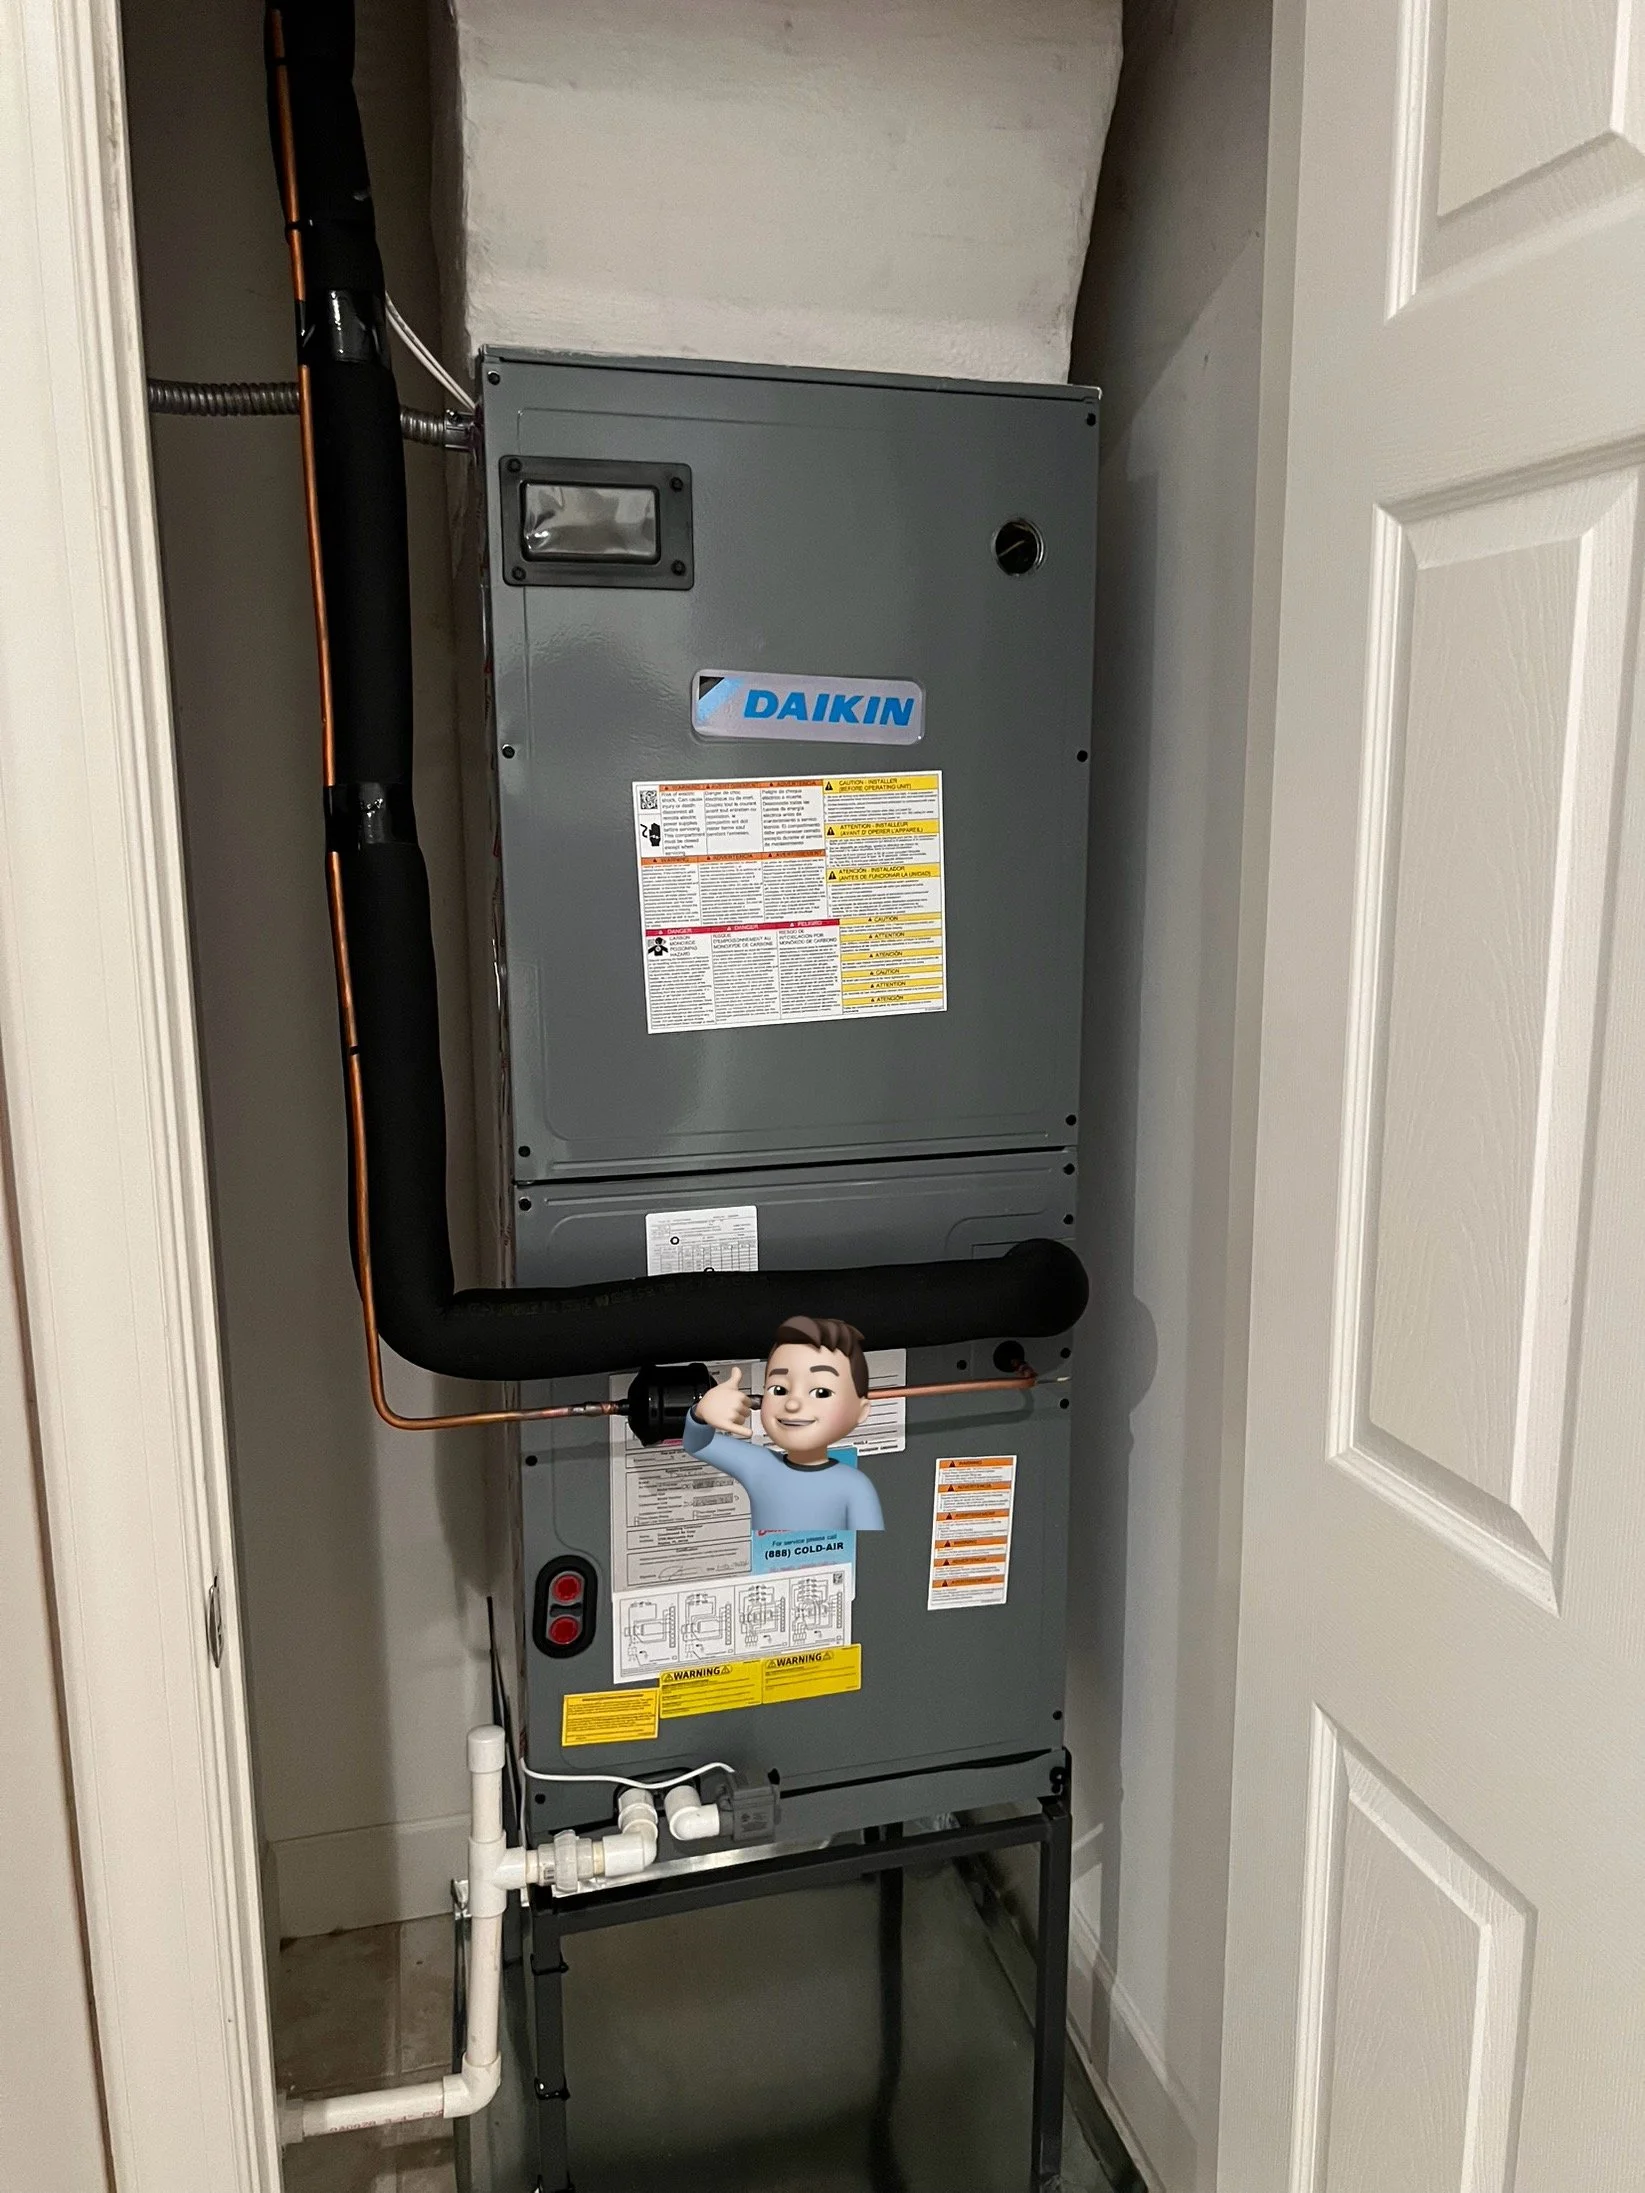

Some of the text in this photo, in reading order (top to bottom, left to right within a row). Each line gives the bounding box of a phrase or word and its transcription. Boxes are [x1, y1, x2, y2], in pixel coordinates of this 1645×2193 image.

[744, 690, 914, 725] DAIKIN
[765, 1542, 844, 1560] (888) COLD-AIR
[776, 1653, 822, 1668] WARNING
[674, 1667, 720, 1680] WARNING
